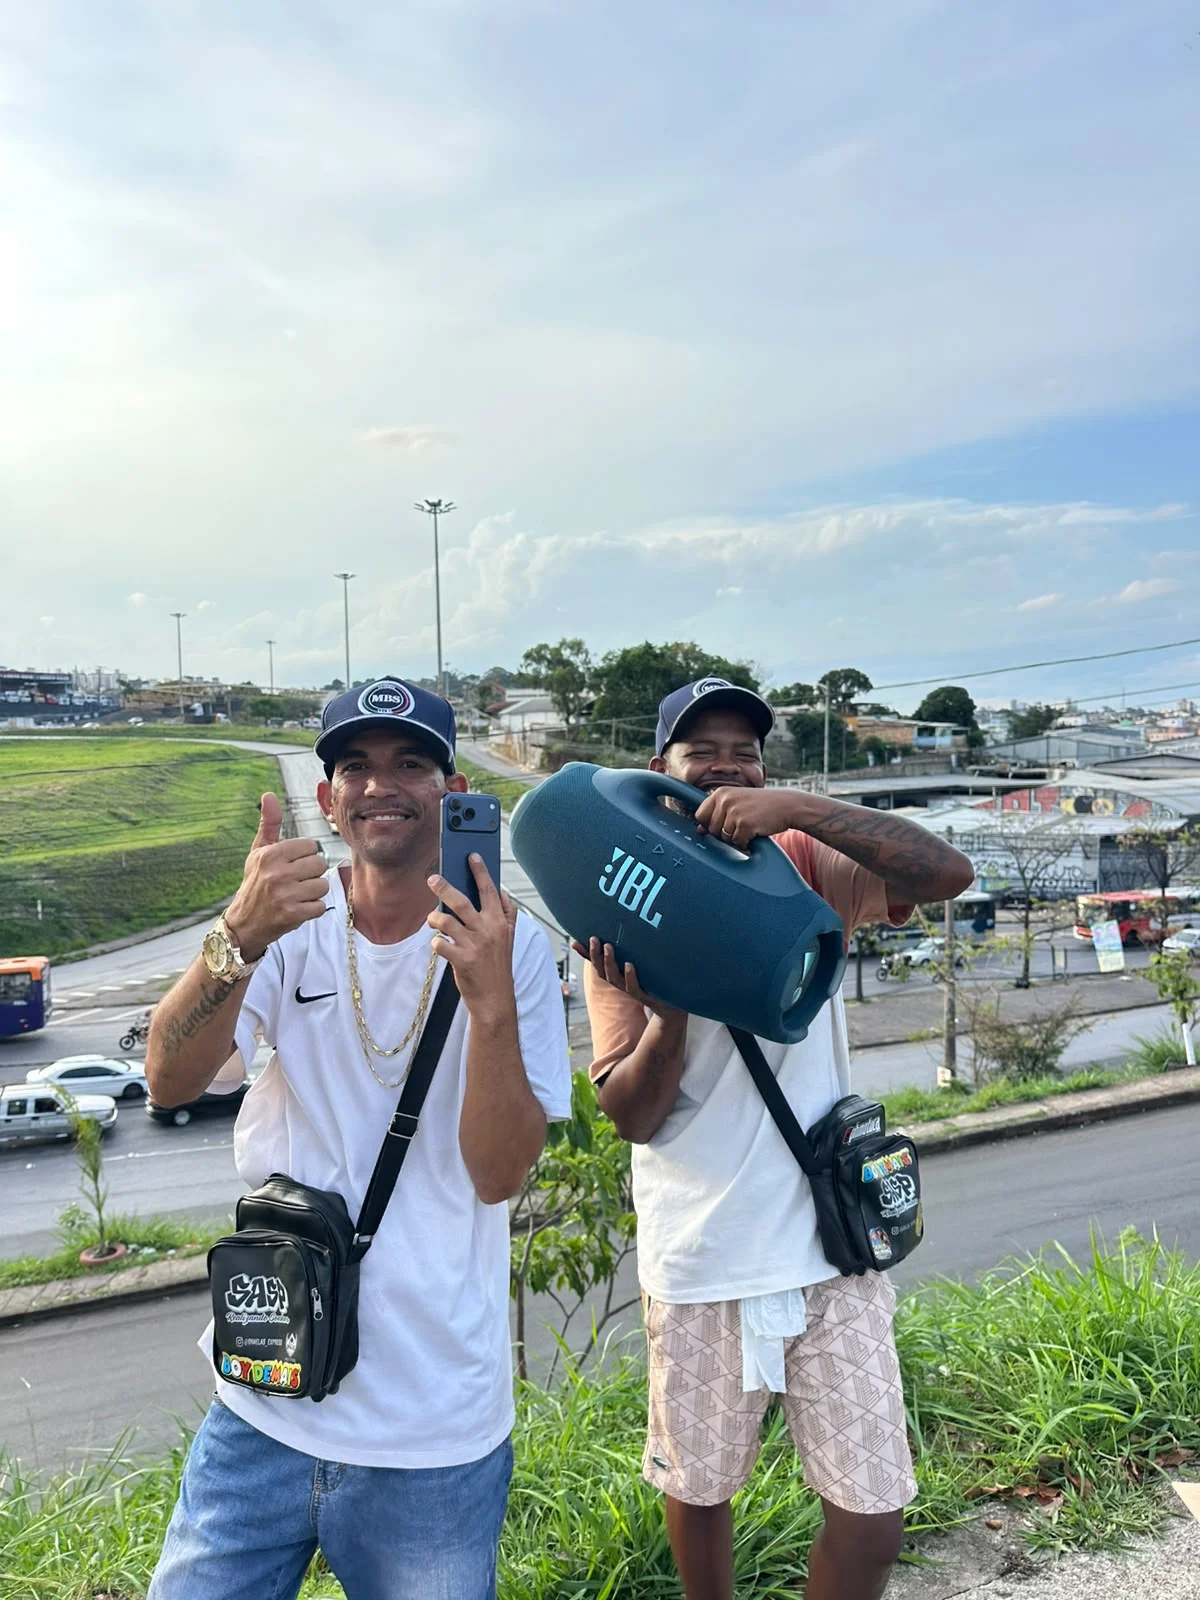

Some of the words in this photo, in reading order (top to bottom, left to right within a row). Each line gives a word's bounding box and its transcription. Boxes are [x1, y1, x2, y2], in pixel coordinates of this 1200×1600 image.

[371, 694, 401, 704] MBS
[598, 855, 667, 929] JBL
[221, 1352, 252, 1382] BOY
[251, 1359, 302, 1389] DEMAIS
